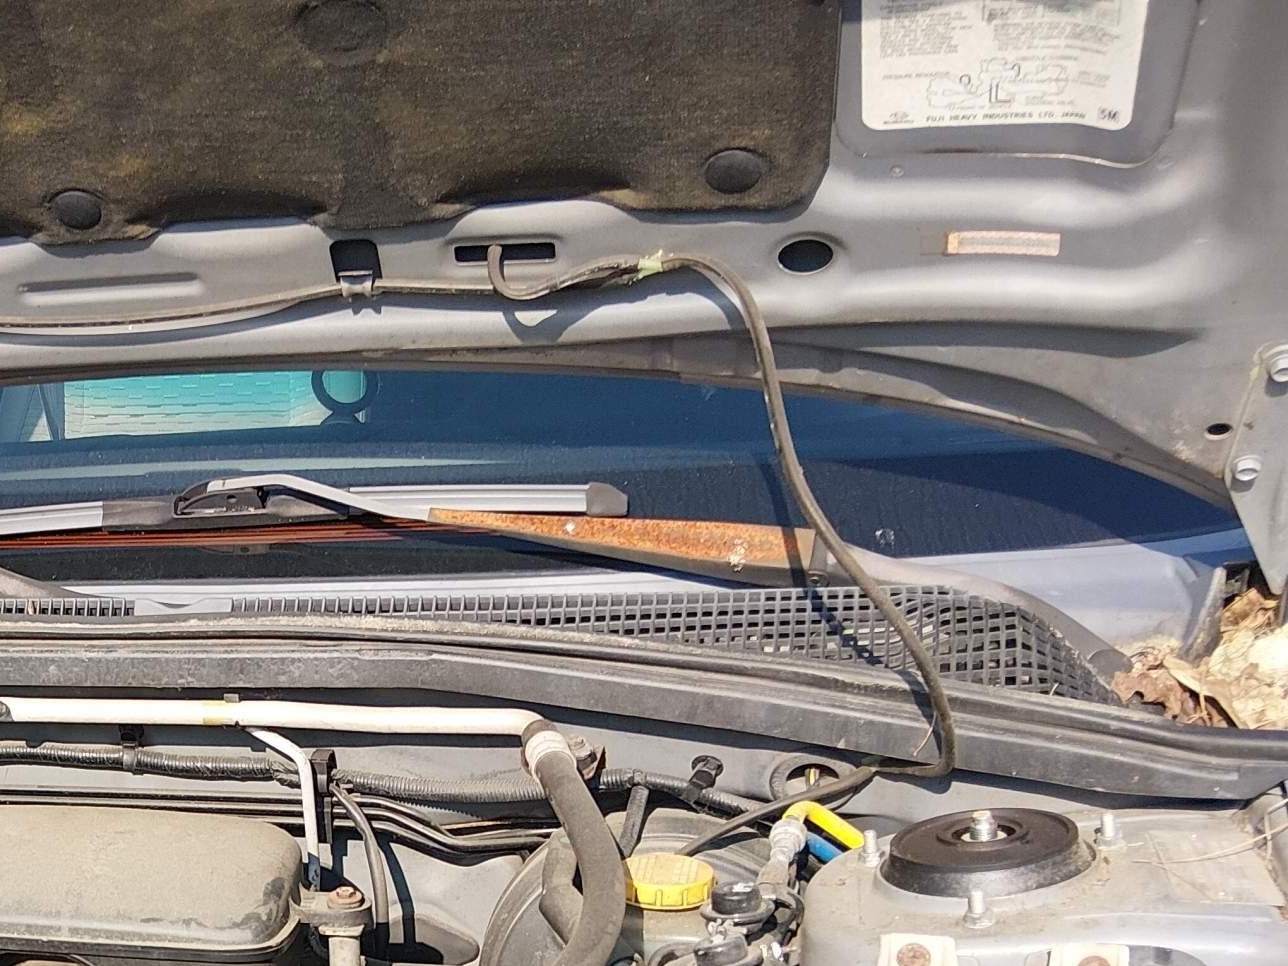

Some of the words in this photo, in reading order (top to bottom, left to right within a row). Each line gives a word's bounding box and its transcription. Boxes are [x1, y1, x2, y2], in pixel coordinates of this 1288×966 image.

[926, 114, 945, 123] FUJI
[949, 113, 977, 122] HEAVY
[982, 111, 1033, 121] INDUSTRIES
